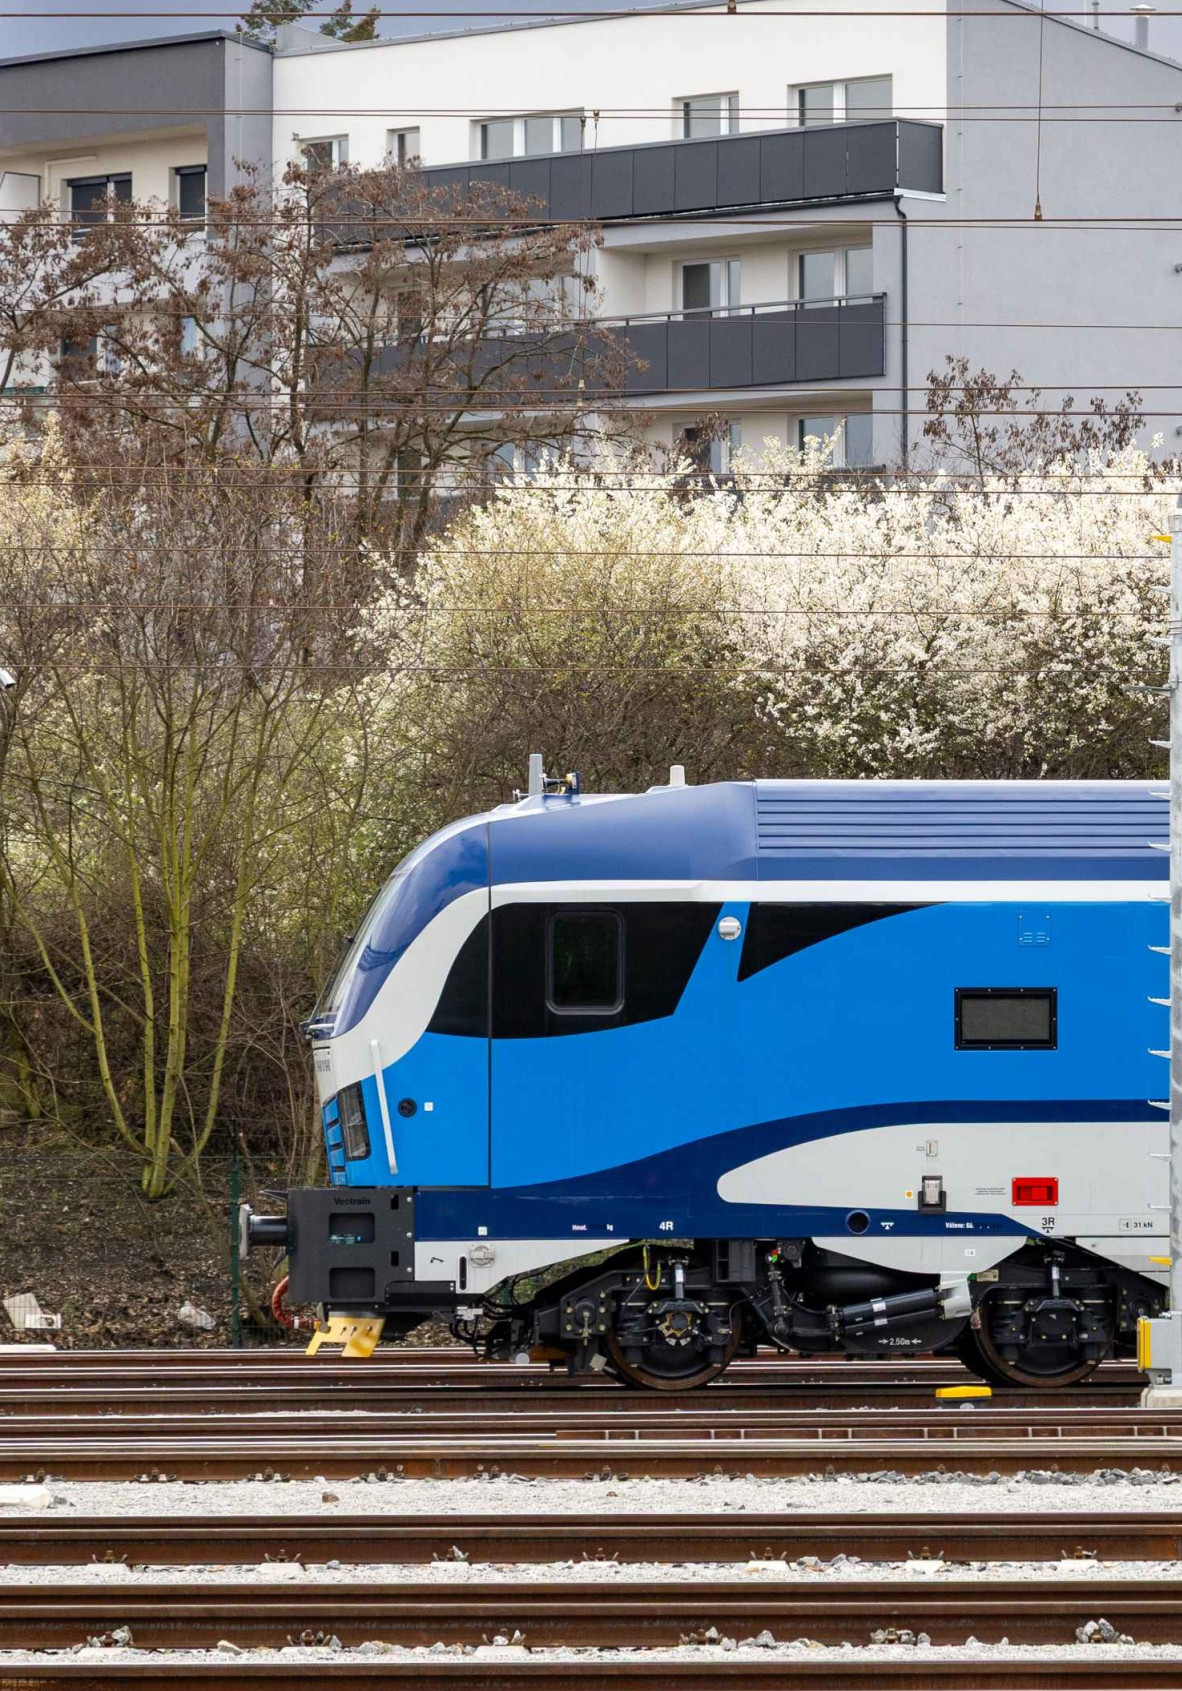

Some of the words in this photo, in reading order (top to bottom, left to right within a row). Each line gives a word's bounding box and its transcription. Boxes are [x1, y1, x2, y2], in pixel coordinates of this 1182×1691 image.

[334, 1196, 371, 1206] Vectrain
[659, 1220, 674, 1231] 4R
[1041, 1217, 1055, 1226] 3R
[1133, 1221, 1142, 1229] 31
[1143, 1221, 1153, 1229] kN
